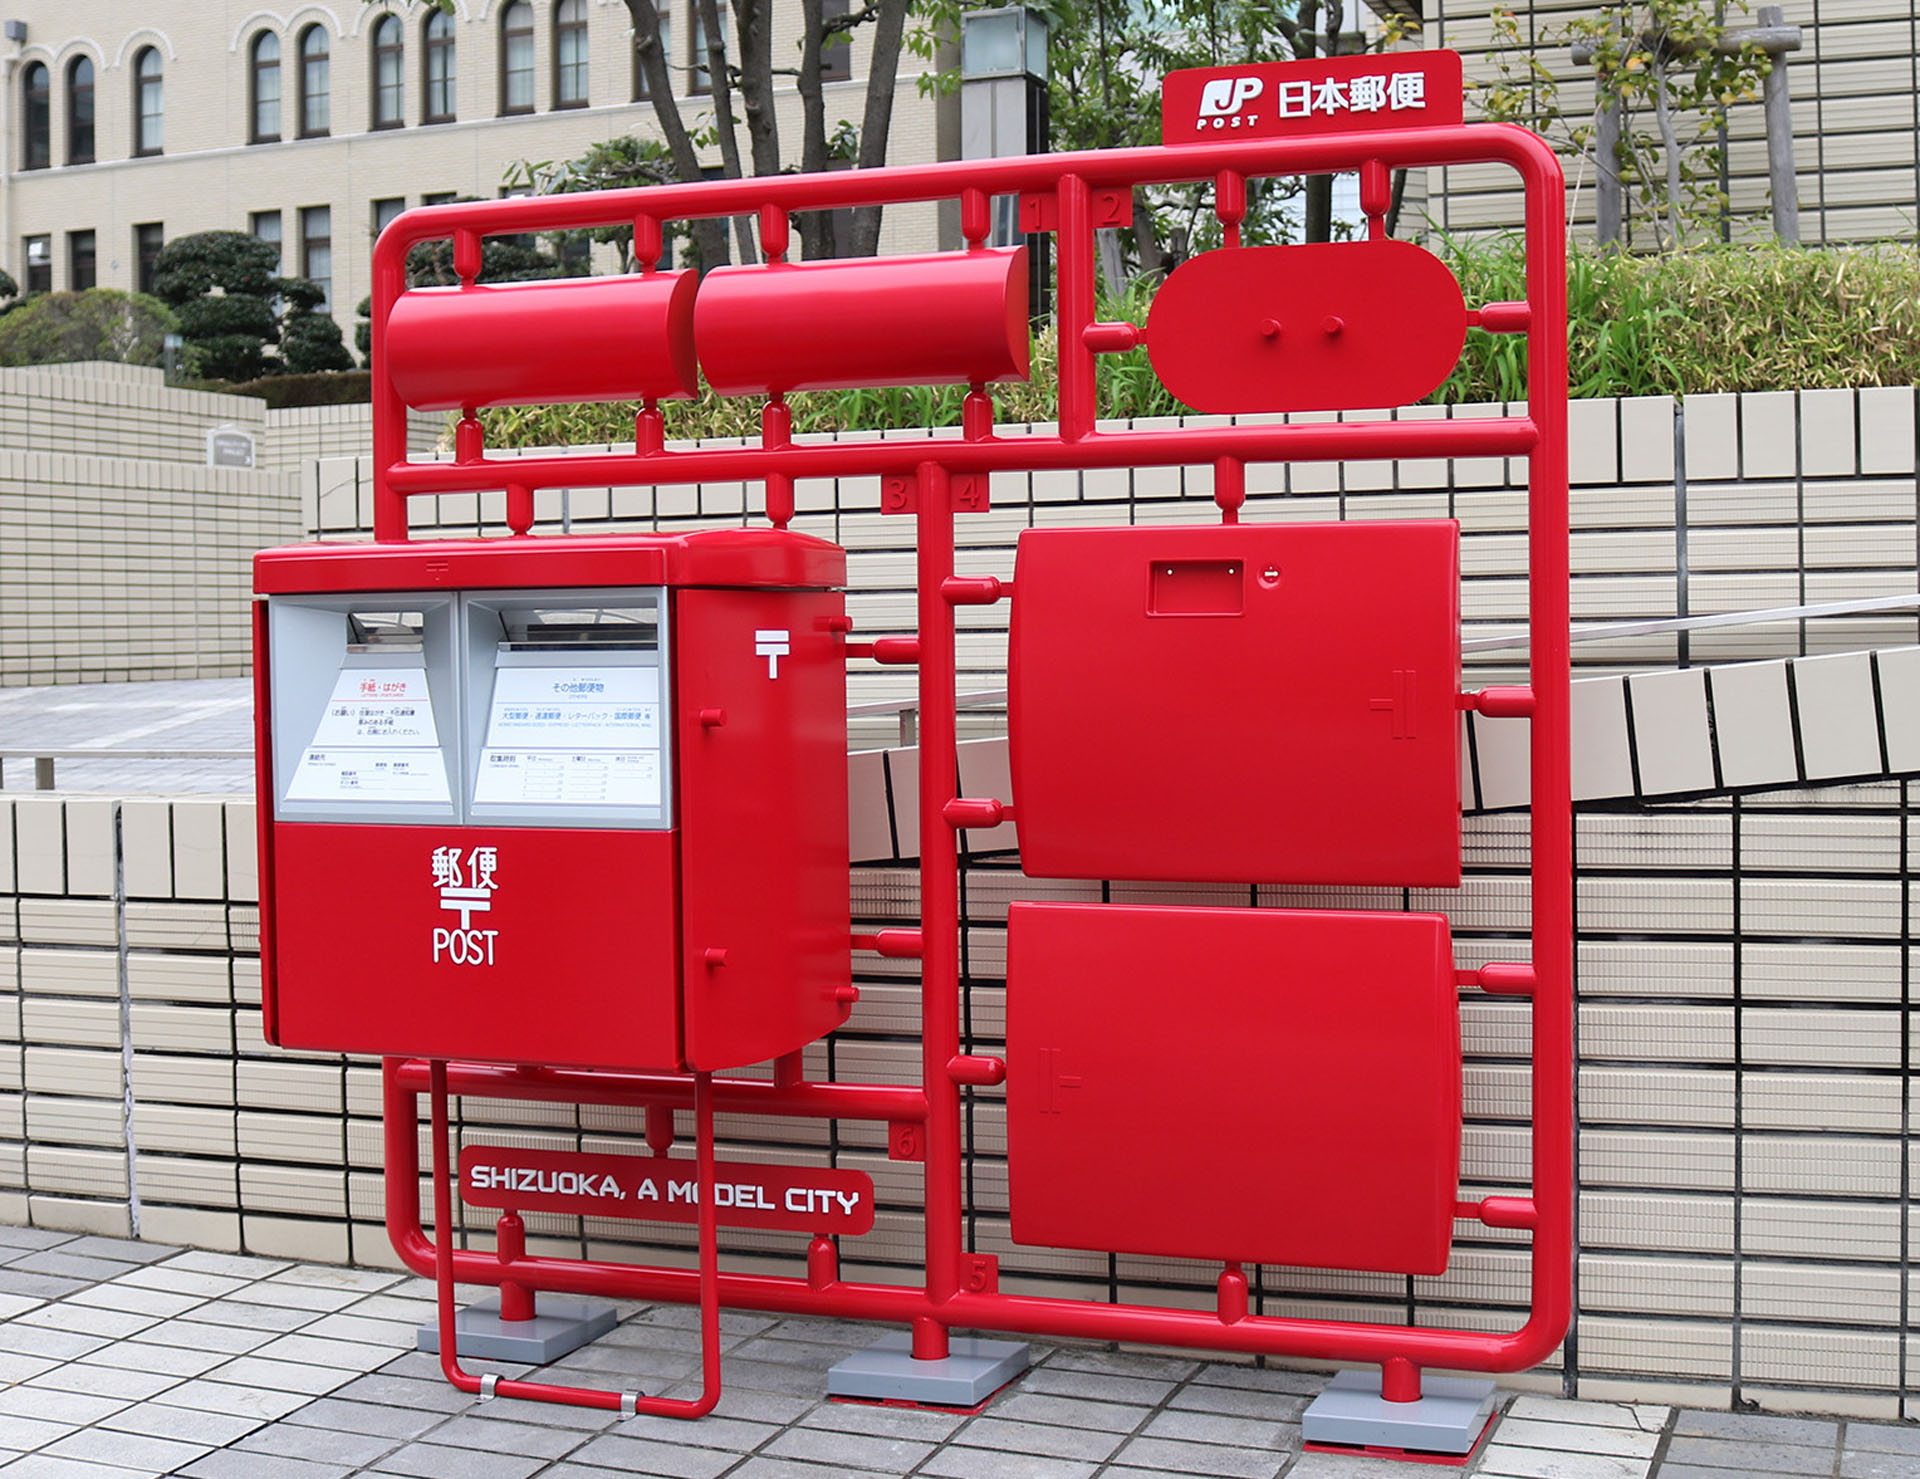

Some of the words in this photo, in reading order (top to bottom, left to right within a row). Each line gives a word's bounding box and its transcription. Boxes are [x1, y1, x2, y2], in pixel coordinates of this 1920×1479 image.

[1279, 72, 1426, 118] 日本郵便
[1196, 115, 1259, 130] POST
[1029, 199, 1042, 229] 1
[1102, 193, 1121, 225] 2
[888, 479, 908, 510] 3
[960, 477, 980, 508] 4
[431, 846, 499, 890] 郵便
[433, 928, 499, 966] POST
[898, 1127, 917, 1157] 6
[470, 1164, 627, 1200] SHIZUOKA,
[637, 1178, 659, 1201] A
[785, 1188, 859, 1215] CITY
[970, 1260, 988, 1292] 5
